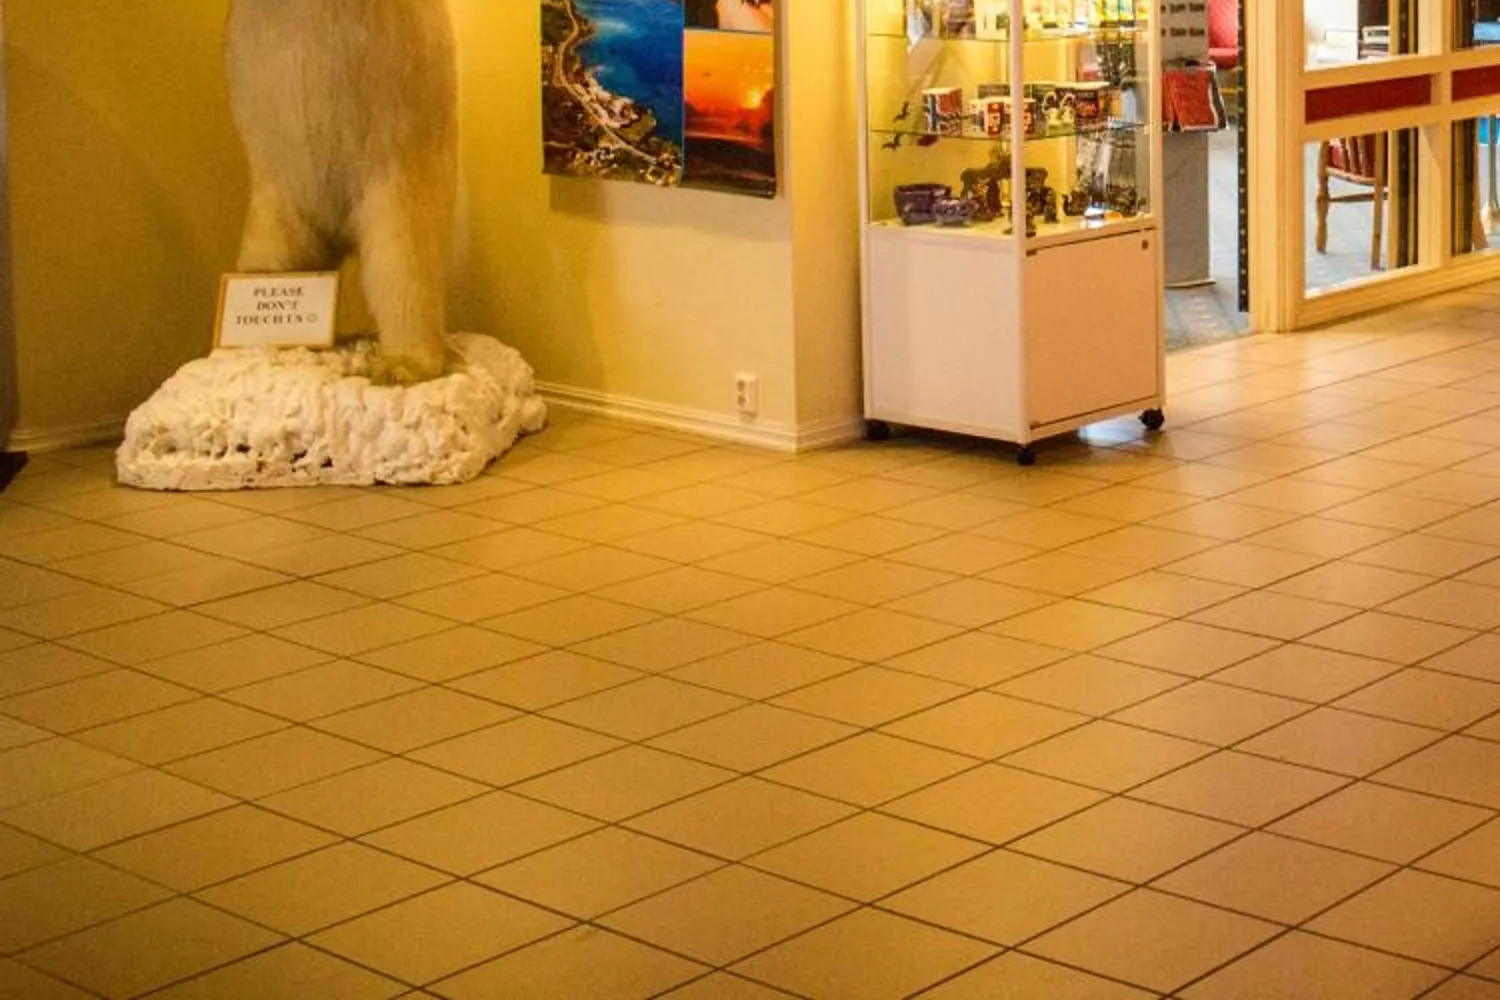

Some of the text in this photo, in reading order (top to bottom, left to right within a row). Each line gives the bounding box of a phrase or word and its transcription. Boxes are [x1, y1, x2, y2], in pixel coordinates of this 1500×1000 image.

[253, 286, 304, 297] PLEASE
[256, 300, 299, 311] DON'T
[236, 313, 284, 325] TOUCH
